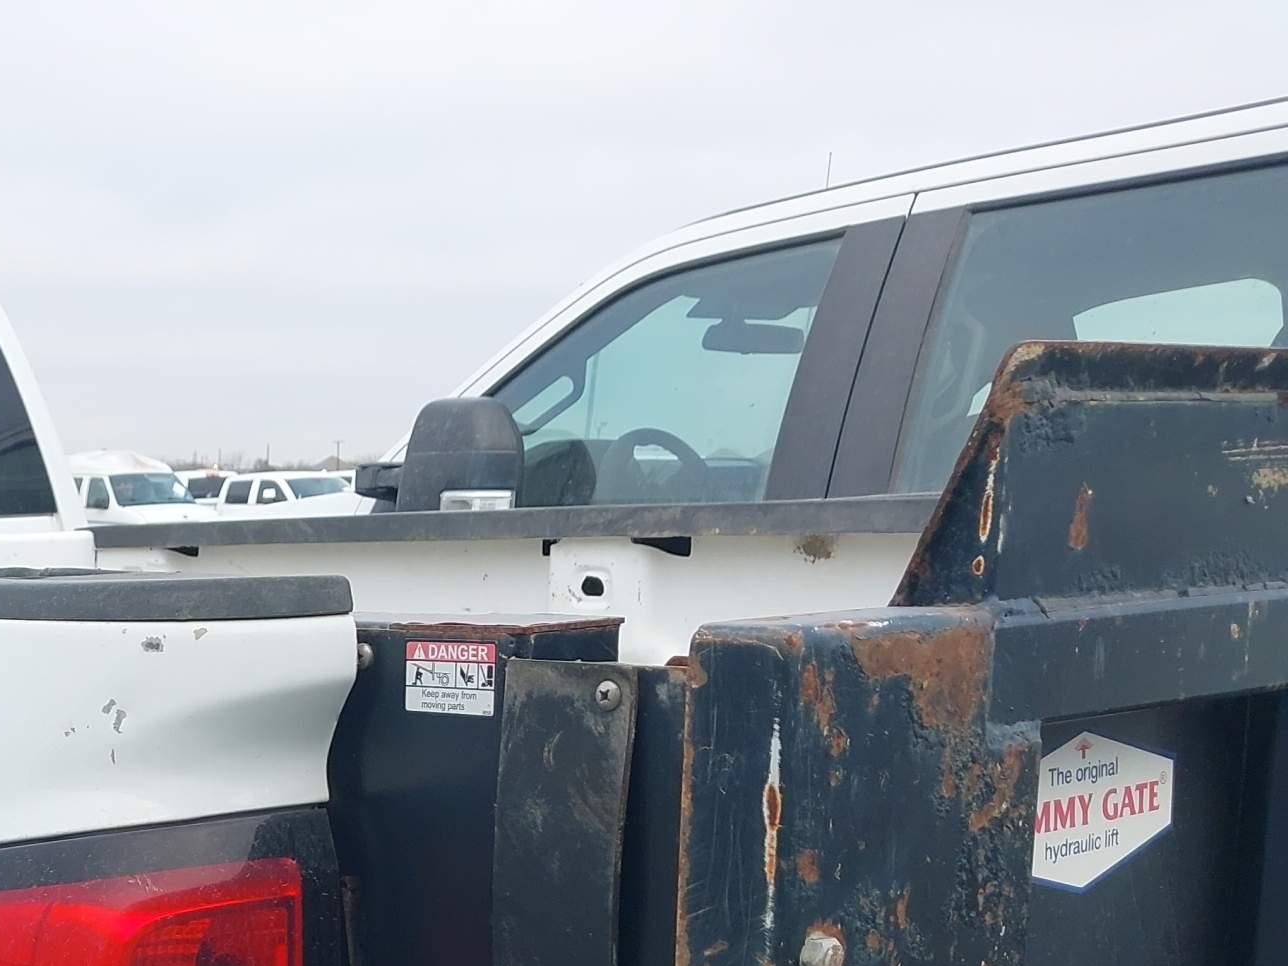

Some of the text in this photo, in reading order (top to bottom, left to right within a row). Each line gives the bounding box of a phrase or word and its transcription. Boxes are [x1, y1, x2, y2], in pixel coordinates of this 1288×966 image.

[429, 644, 488, 660] DANGER
[422, 689, 477, 700] Keep away from
[421, 702, 465, 711] moving parts
[1049, 757, 1118, 787] The original
[1045, 829, 1119, 863] hydraulic lift
